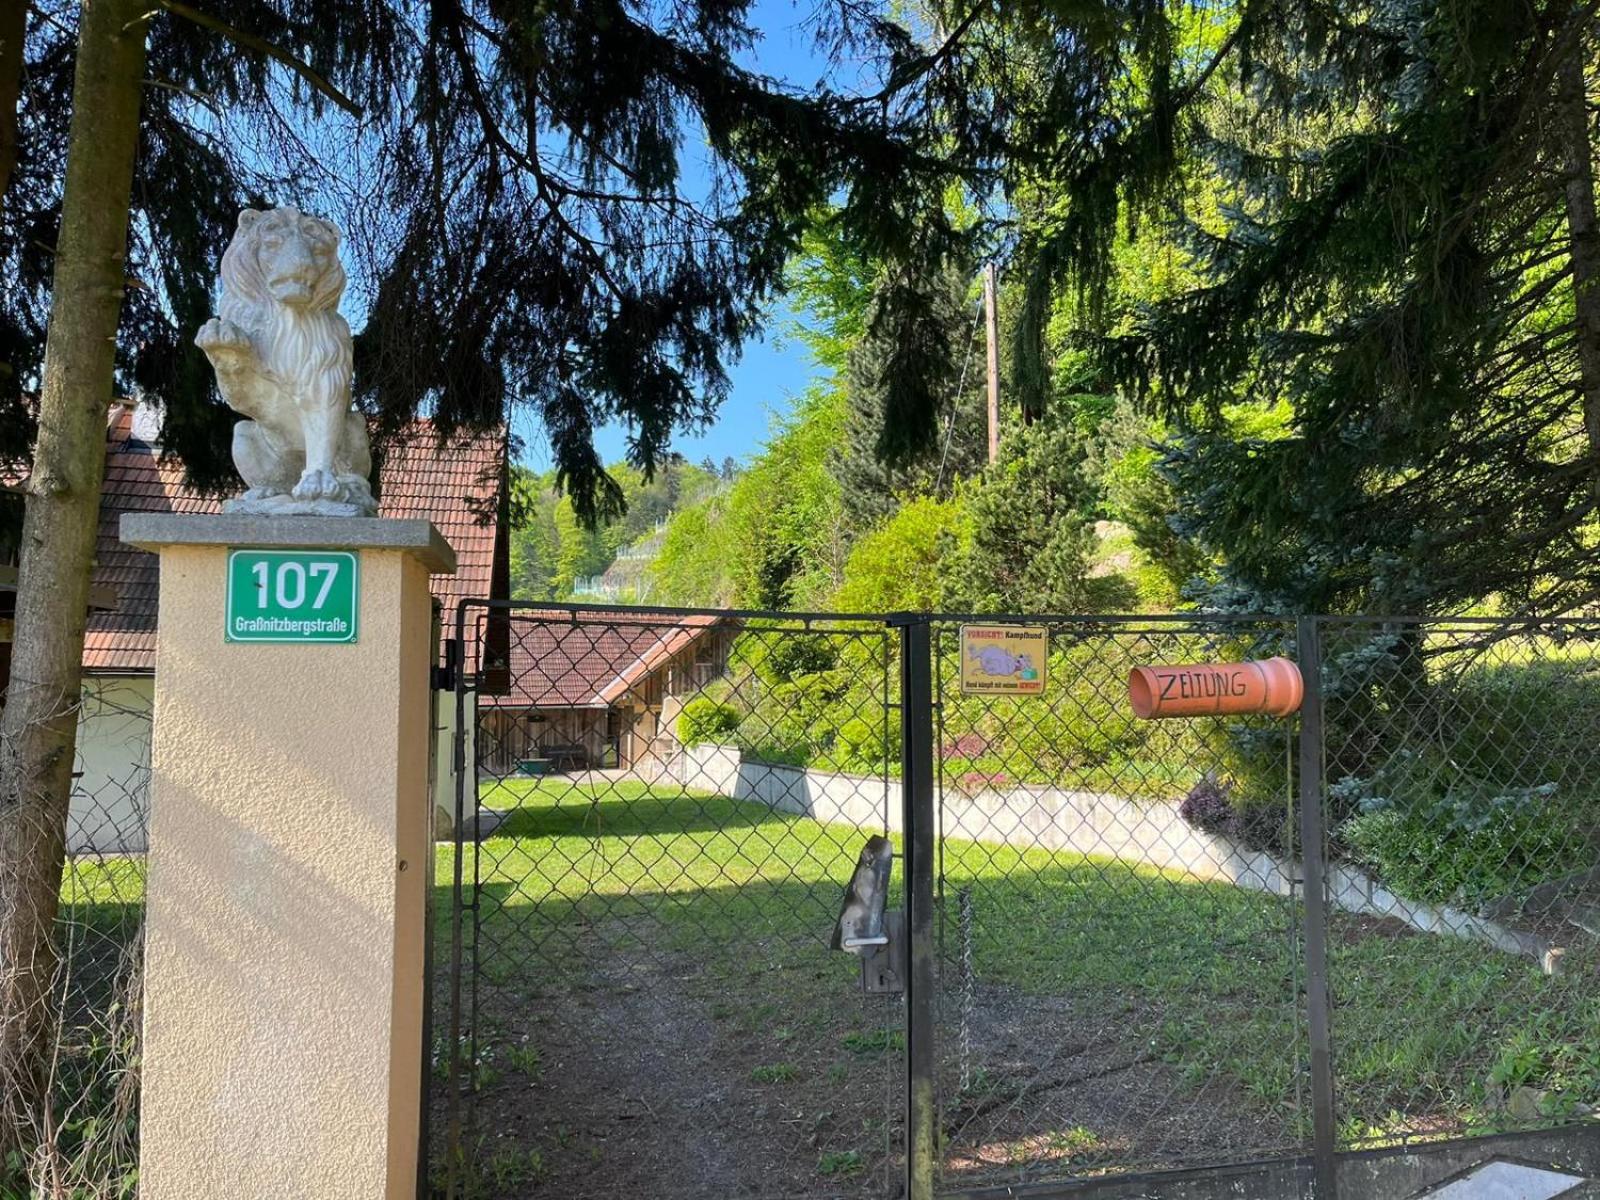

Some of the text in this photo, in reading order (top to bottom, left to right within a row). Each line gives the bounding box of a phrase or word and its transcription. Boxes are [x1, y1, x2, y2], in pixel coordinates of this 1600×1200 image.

[252, 562, 339, 609] 107
[235, 616, 348, 636] Graßnitzbergstraße
[1005, 631, 1042, 641] Kampfhund
